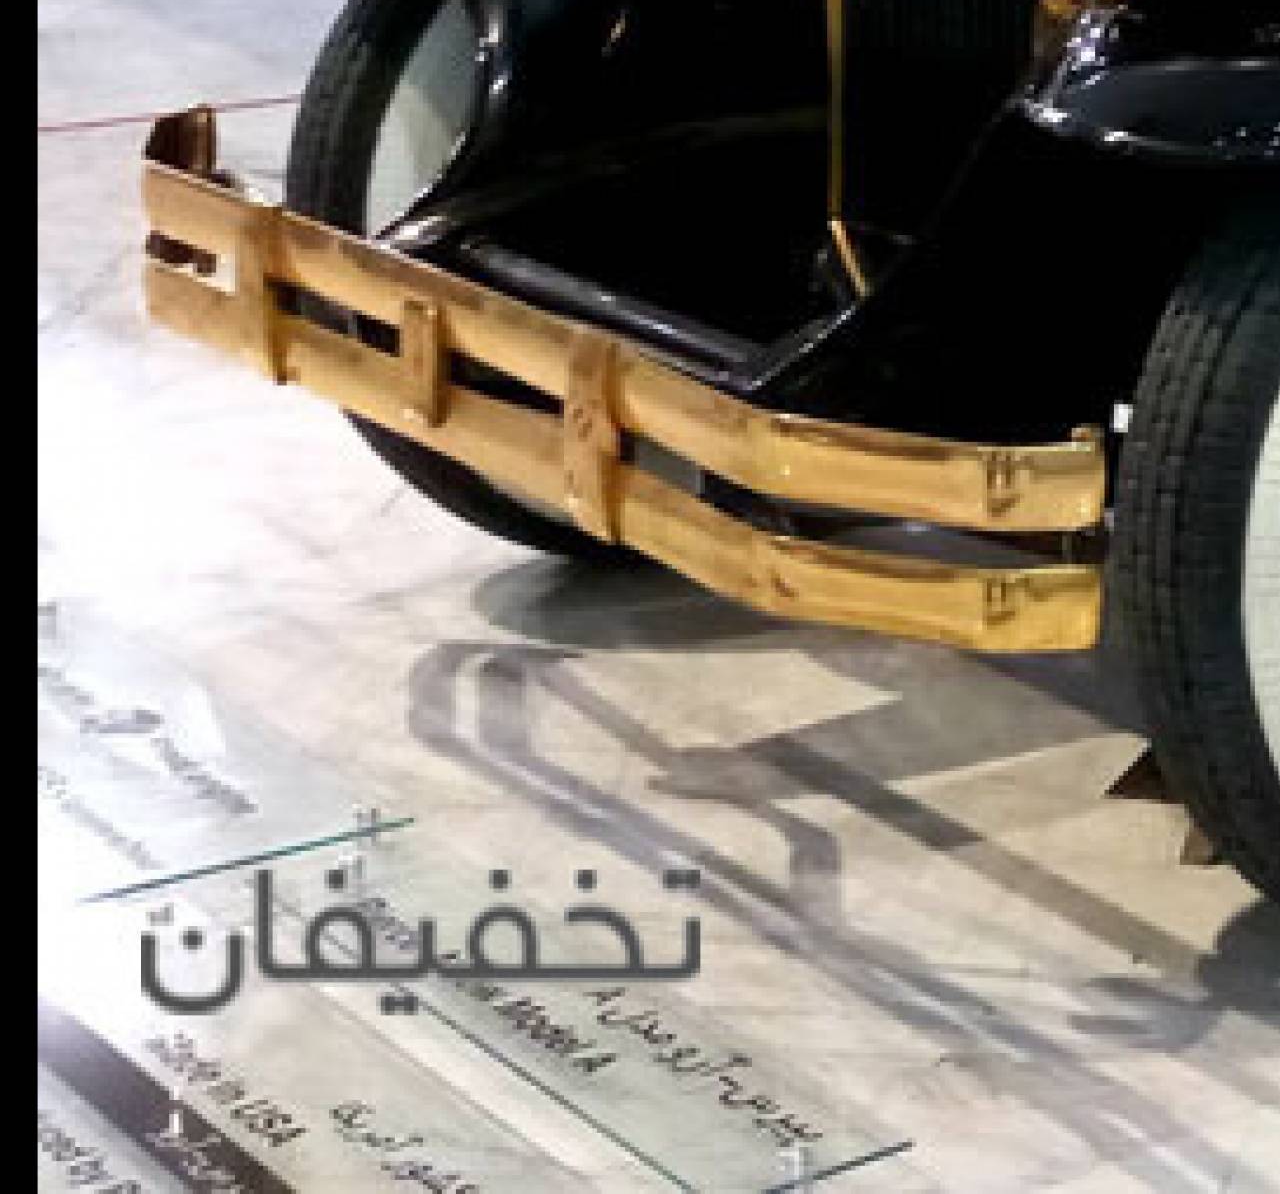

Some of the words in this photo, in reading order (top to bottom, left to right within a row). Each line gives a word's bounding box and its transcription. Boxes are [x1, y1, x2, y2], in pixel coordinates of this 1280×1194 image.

[496, 996, 597, 1055] Model
[572, 1052, 616, 1073] A
[230, 1099, 307, 1148] USA
